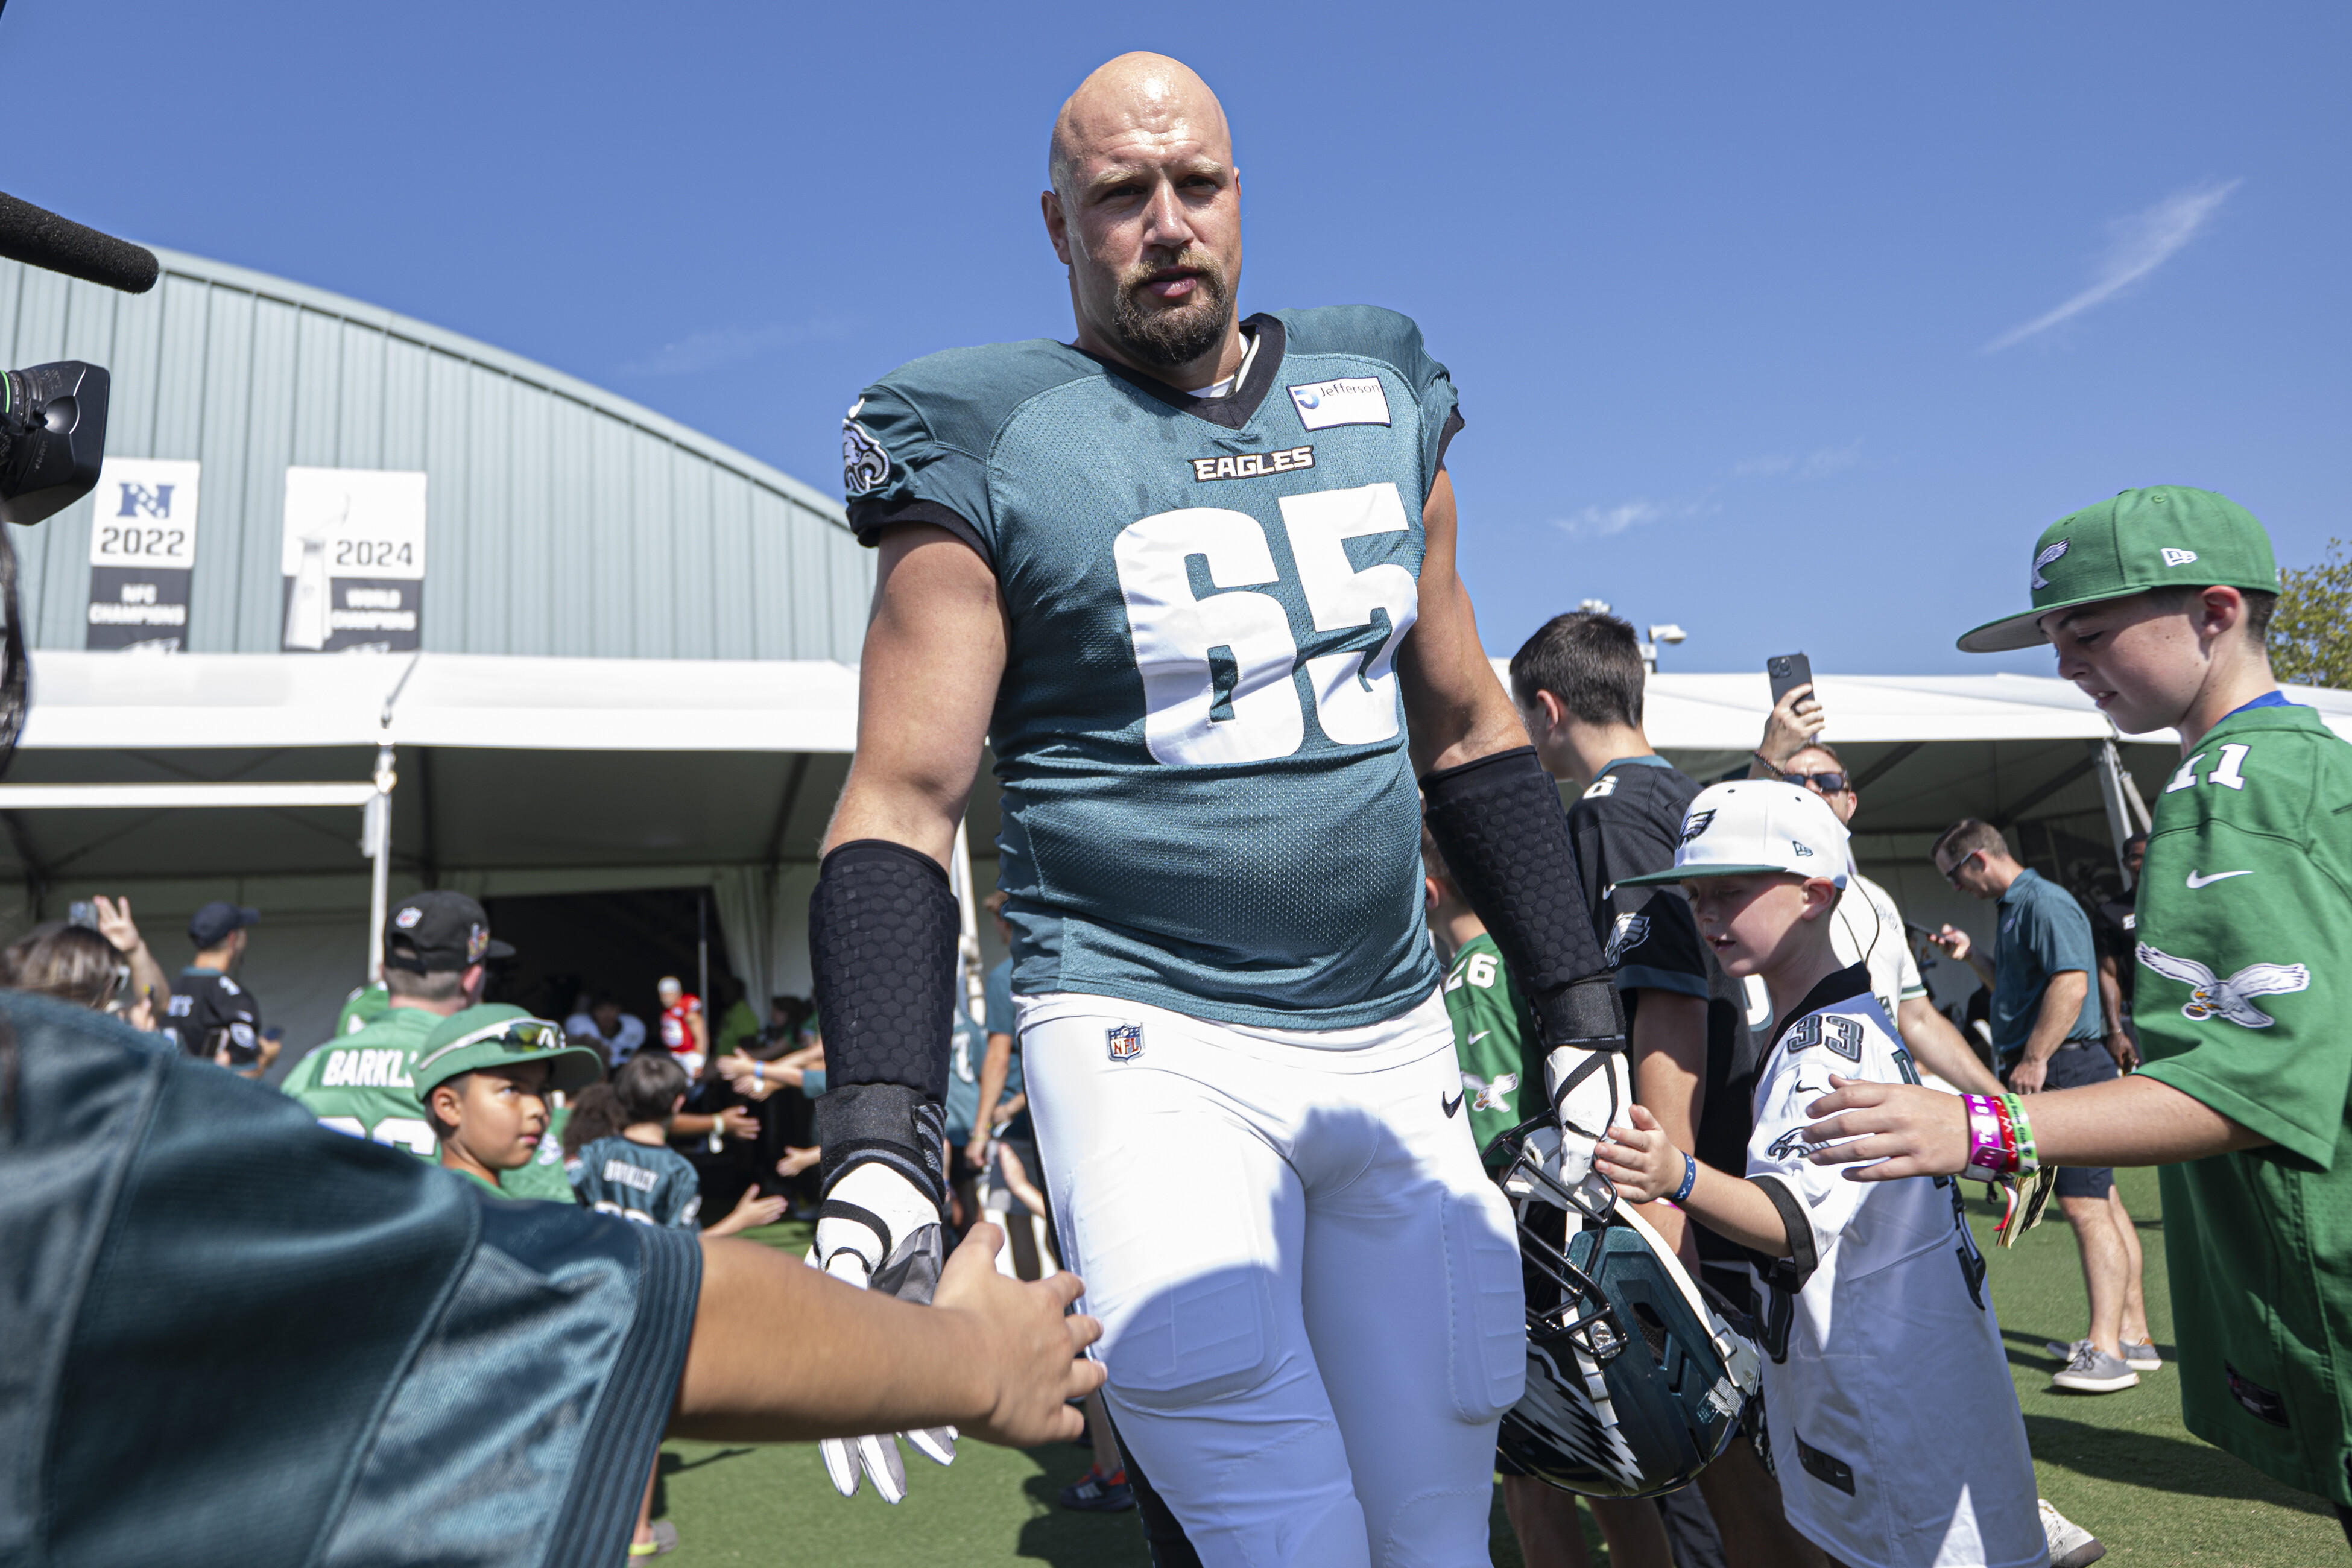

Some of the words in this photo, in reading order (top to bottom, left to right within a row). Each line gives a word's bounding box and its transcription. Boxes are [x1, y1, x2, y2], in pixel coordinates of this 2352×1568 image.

[1320, 382, 1380, 397] Jefferson
[1193, 447, 1314, 481] EAGLES
[100, 526, 185, 556] 2022
[335, 540, 413, 567] 2024
[1113, 482, 1418, 765] 65
[2164, 742, 2252, 794] 11
[1444, 952, 1499, 996] 26
[1113, 1037, 1139, 1055] NFL
[1787, 1014, 1864, 1064] 33
[321, 1048, 419, 1088] BARKL
